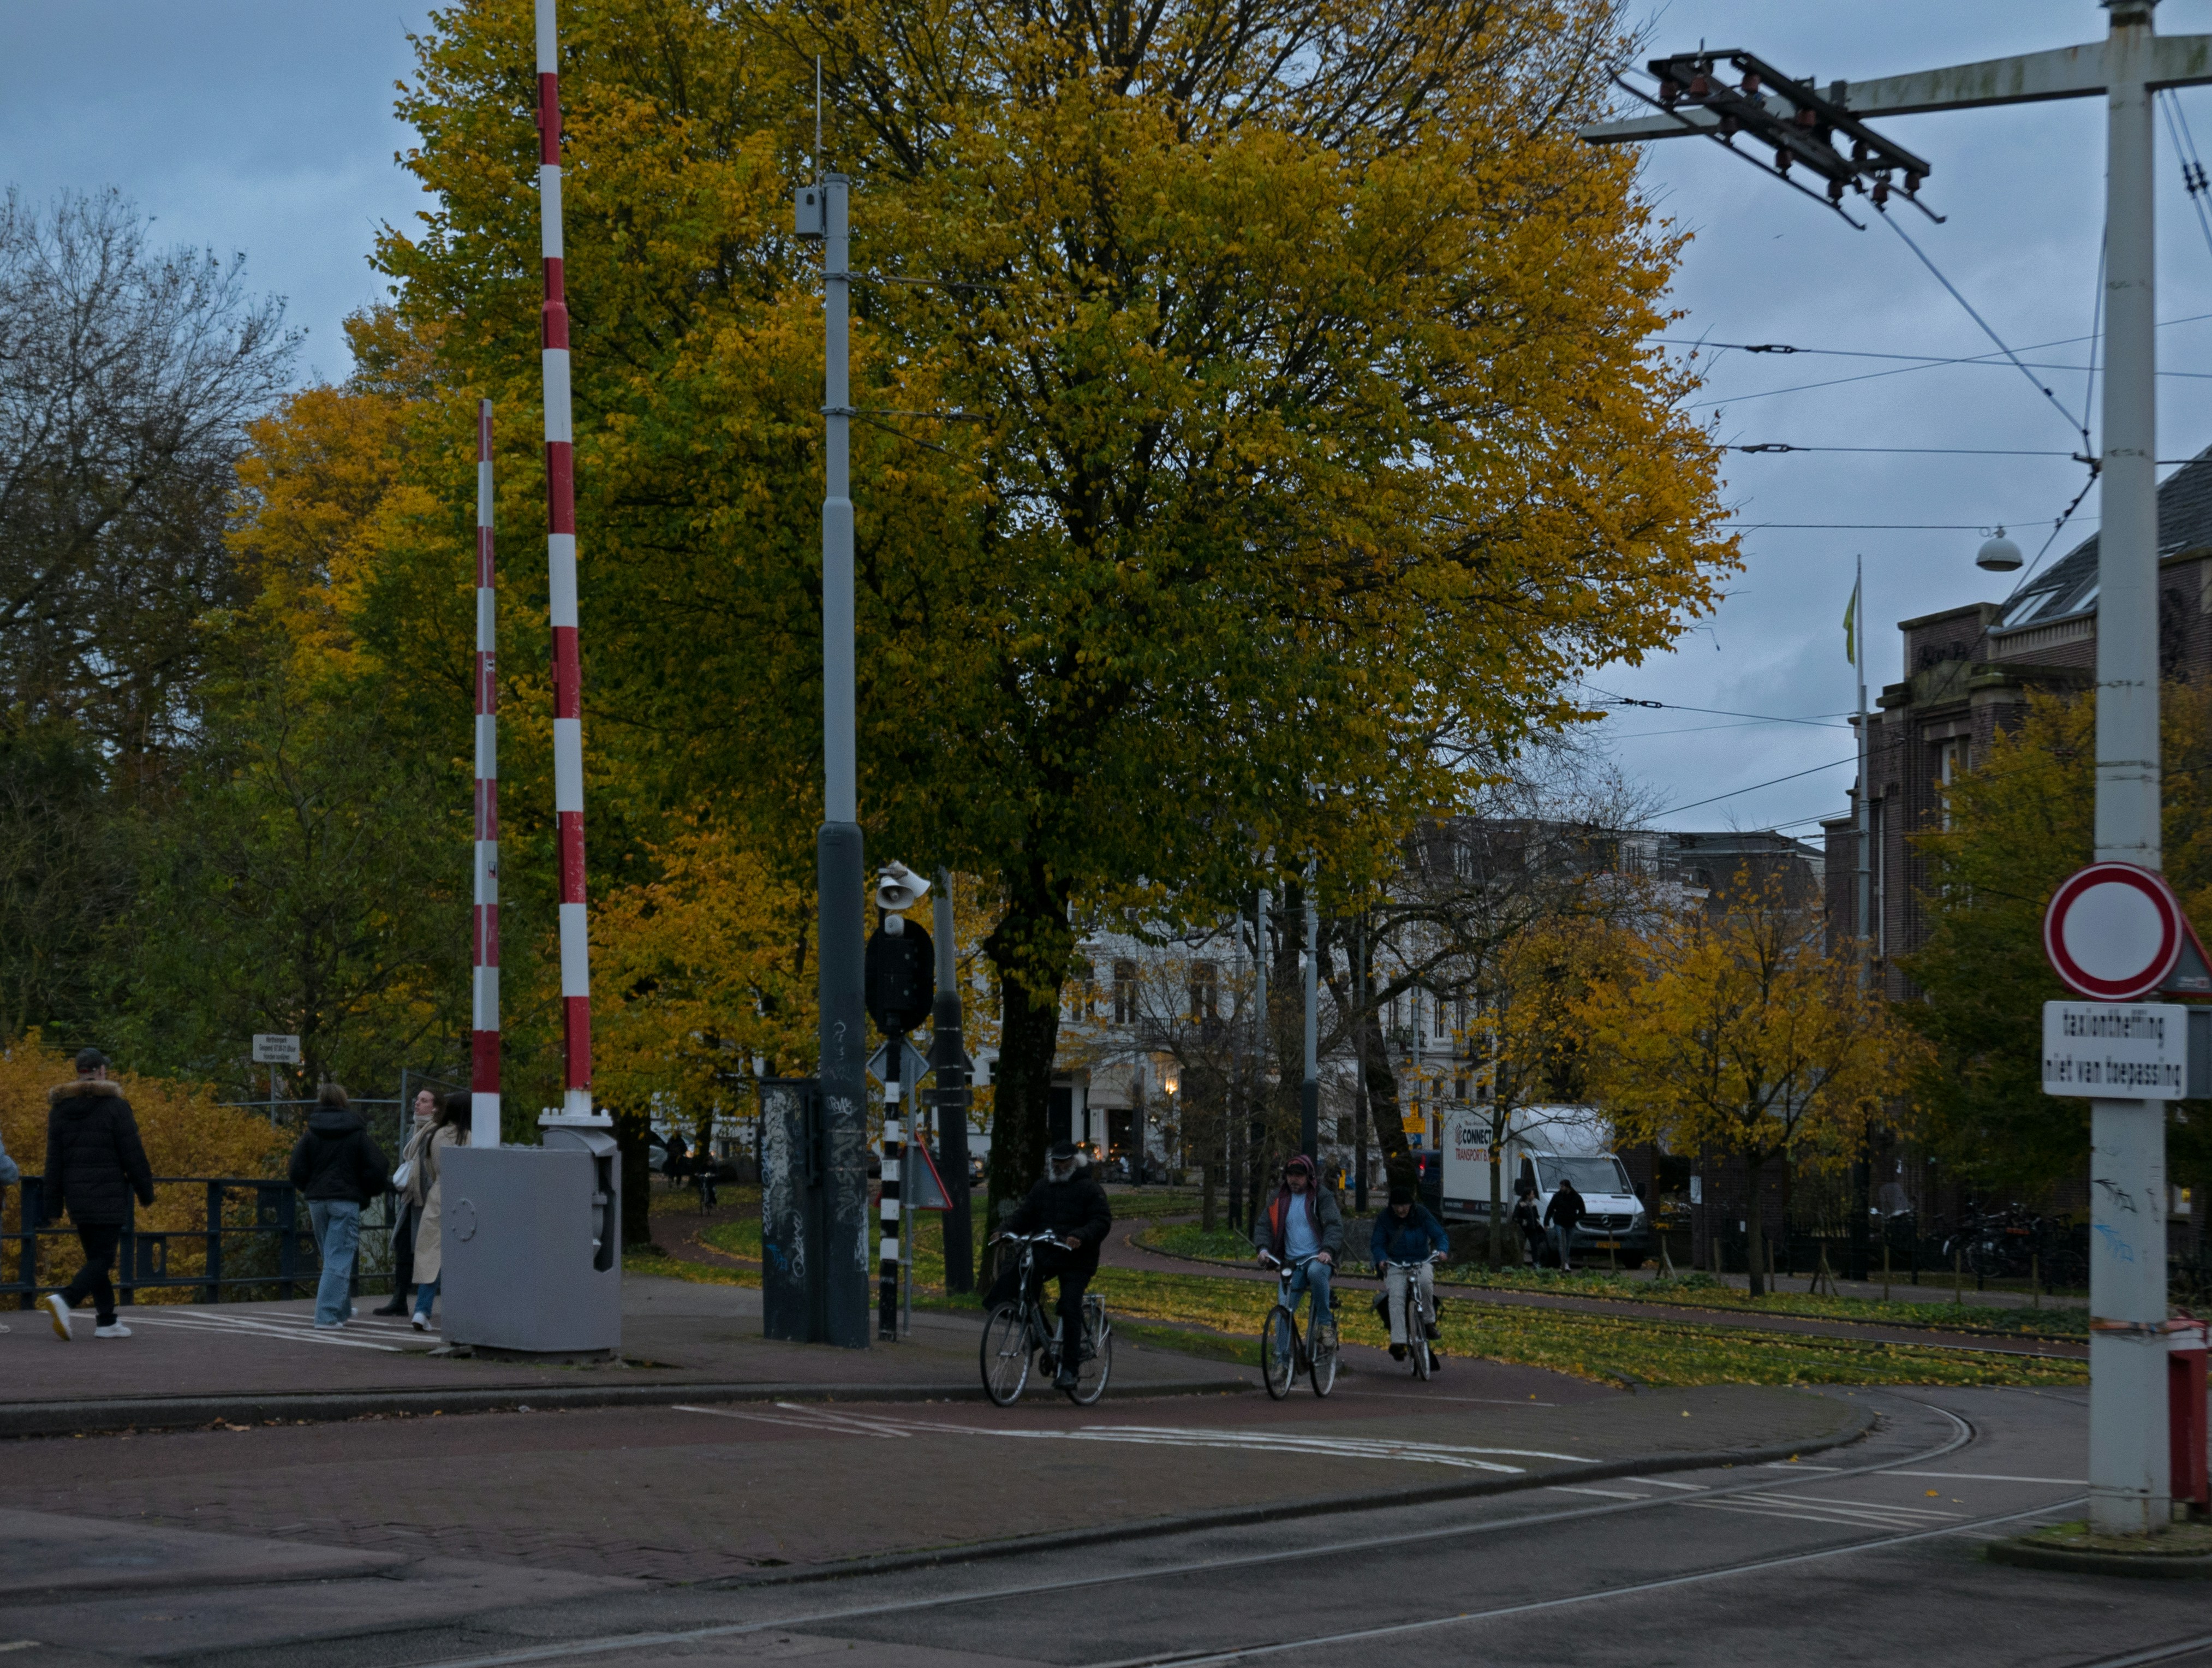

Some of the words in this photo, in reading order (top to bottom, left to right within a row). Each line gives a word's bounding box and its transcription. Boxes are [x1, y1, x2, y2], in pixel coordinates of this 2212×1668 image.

[2043, 1053, 2073, 1082] niet
[2076, 1060, 2101, 1083] van
[2106, 1055, 2182, 1096] toepassing
[1463, 1129, 1492, 1144] CONNECT
[1456, 1148, 1483, 1162] TRANSPORT
